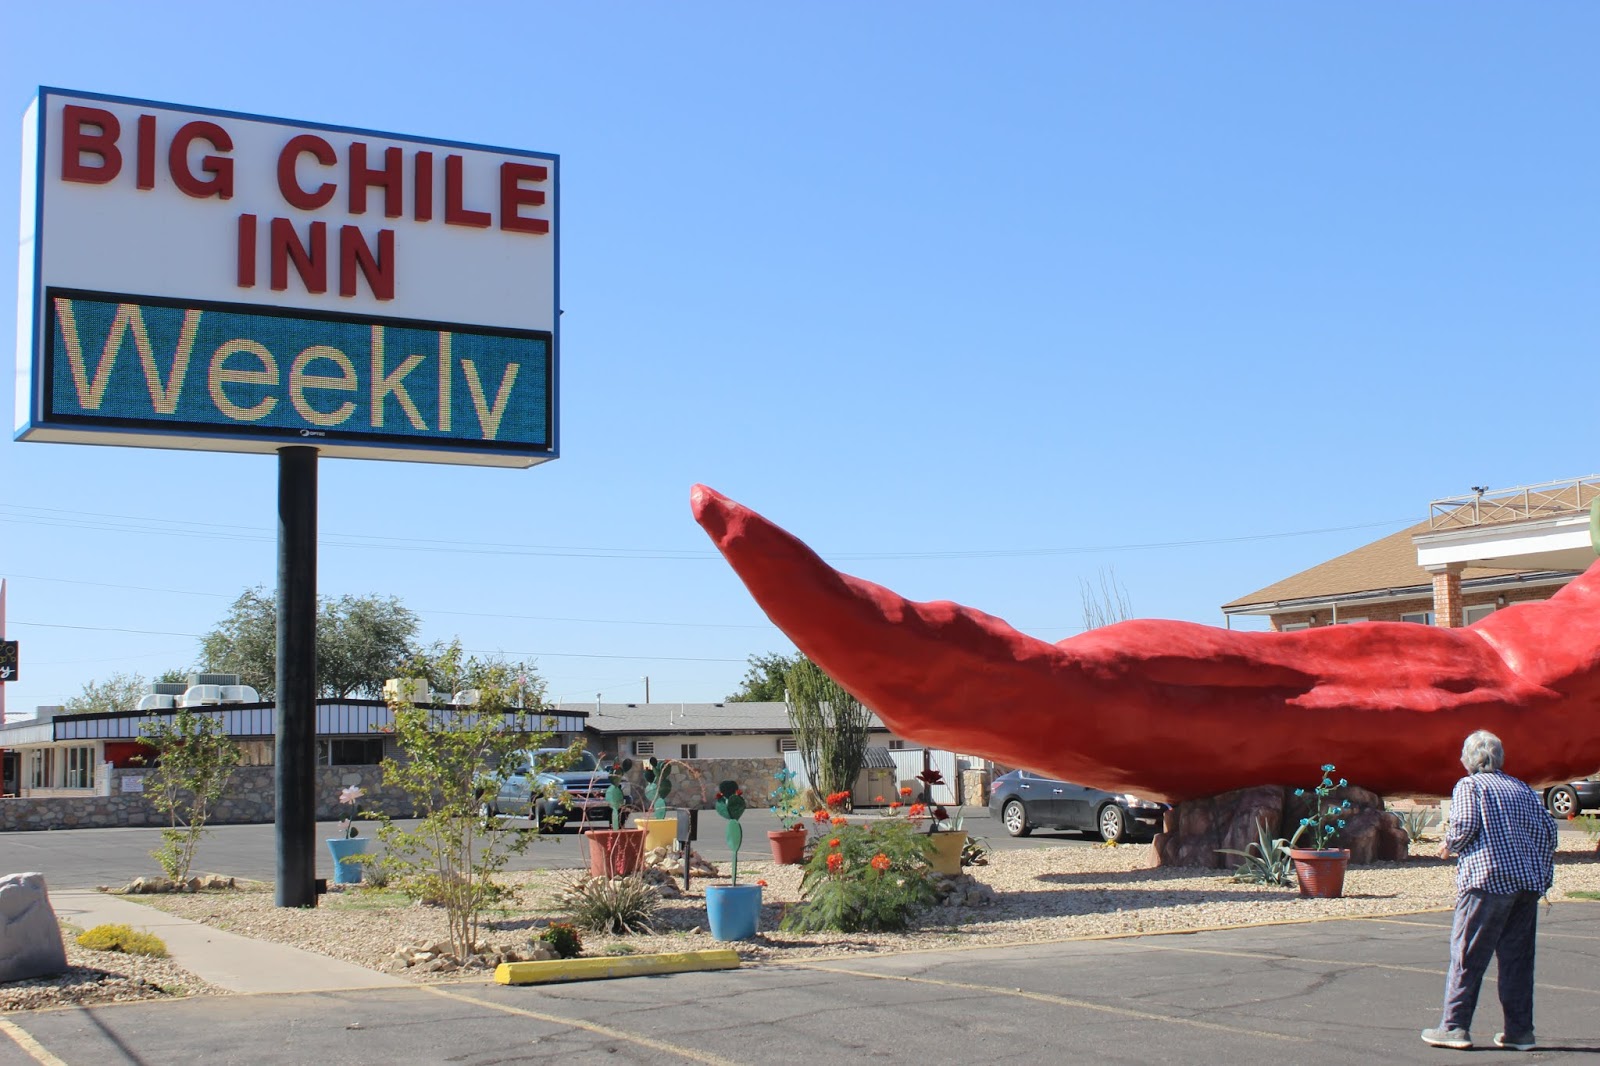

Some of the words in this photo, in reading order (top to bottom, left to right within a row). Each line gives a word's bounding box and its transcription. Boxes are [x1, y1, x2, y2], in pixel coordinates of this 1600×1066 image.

[62, 104, 234, 200] BIG
[277, 134, 549, 234] CHILE
[238, 213, 394, 300] INN
